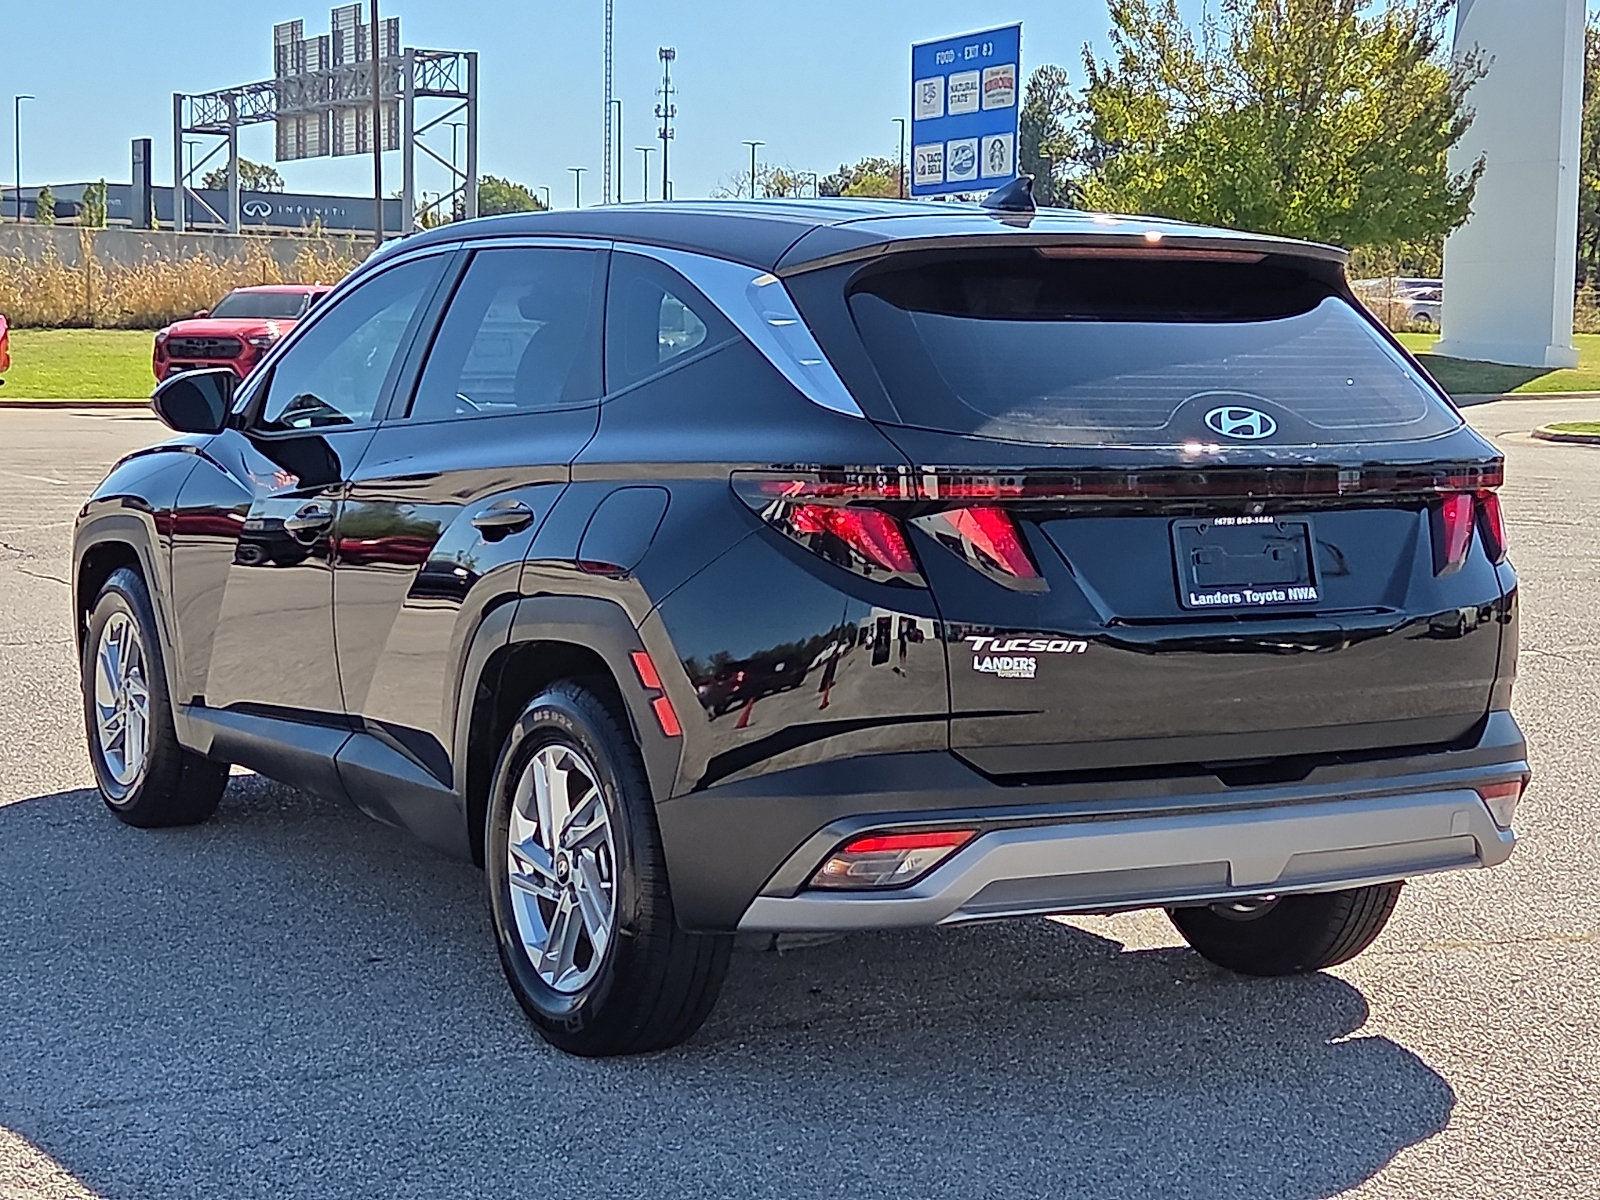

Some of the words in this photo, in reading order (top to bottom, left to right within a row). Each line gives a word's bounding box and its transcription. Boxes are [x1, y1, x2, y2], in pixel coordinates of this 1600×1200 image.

[951, 81, 977, 93] NATURAL
[950, 93, 968, 104] STATE
[927, 152, 942, 164] TACO
[927, 164, 942, 175] BELL
[278, 205, 345, 216] INFINITI
[1190, 592, 1241, 605] Landers
[1243, 589, 1285, 605] Toyota
[1287, 587, 1317, 600] NWA
[973, 656, 1037, 671] LANDERS
